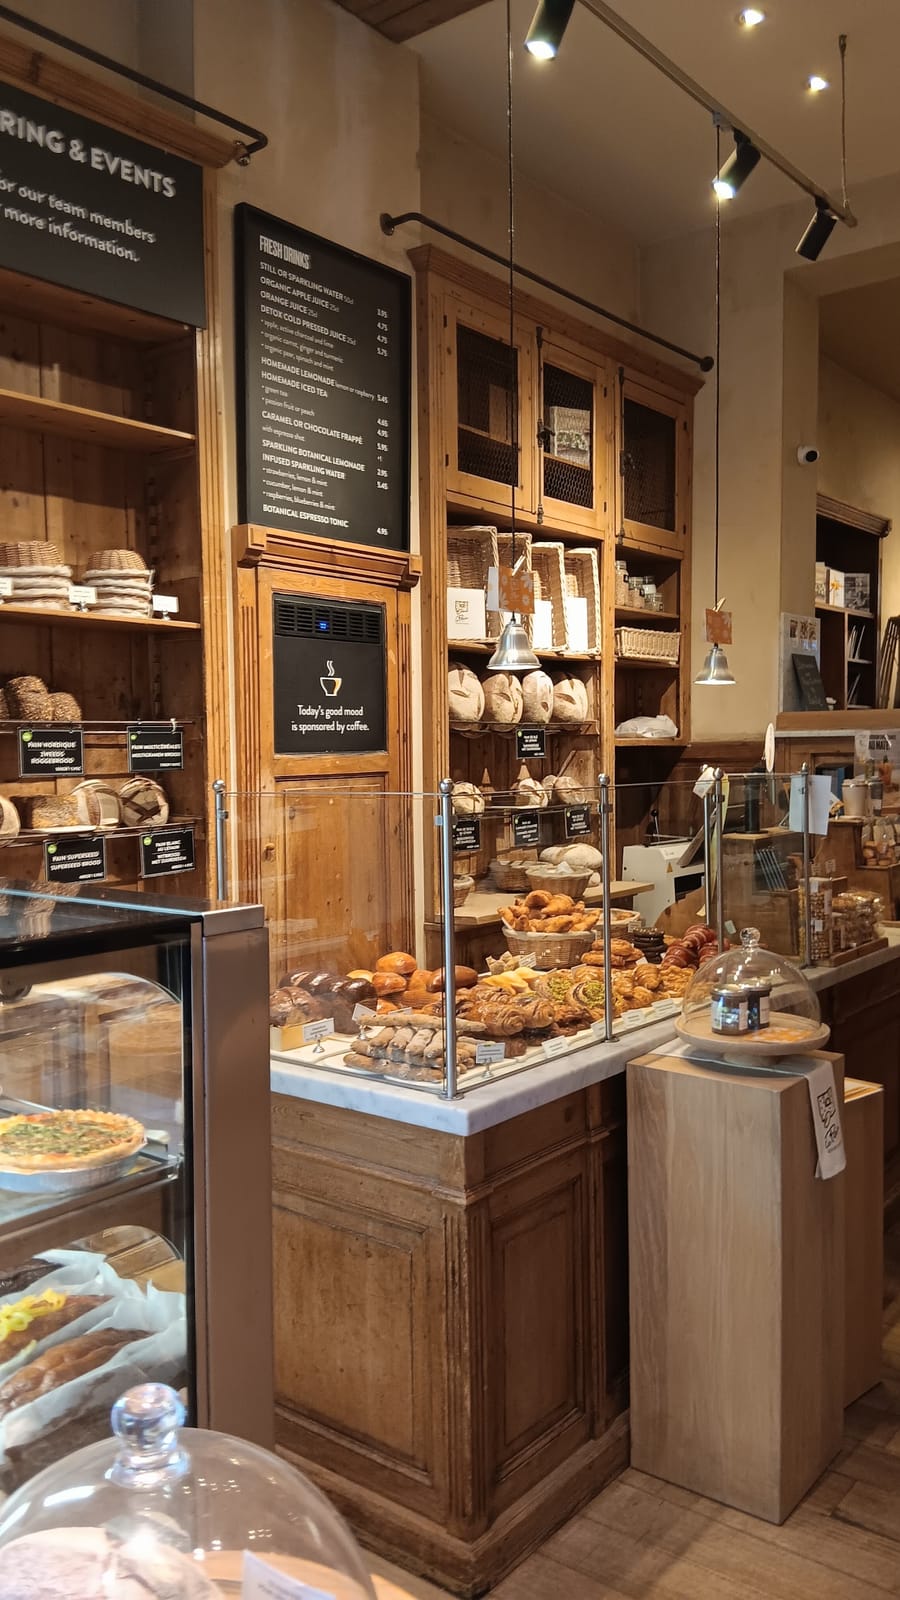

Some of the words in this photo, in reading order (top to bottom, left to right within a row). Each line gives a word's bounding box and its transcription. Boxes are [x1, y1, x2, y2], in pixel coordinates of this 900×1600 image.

[69, 138, 87, 163] &
[90, 147, 177, 198] EVENTS
[0, 169, 17, 193] or
[18, 186, 47, 204] our
[48, 194, 86, 219] team
[90, 210, 156, 243] members
[4, 206, 46, 230] more
[48, 215, 140, 262] information.
[260, 235, 283, 259] FRESH
[283, 245, 310, 270] DRINKS
[260, 261, 277, 275] STILL
[277, 269, 288, 279] OR
[288, 273, 323, 293] SPARKLING
[323, 286, 344, 301] WATER
[260, 276, 291, 294] ORGANIC
[291, 288, 311, 302] APPLE
[311, 295, 329, 309] JUICE
[260, 290, 289, 307] ORANGE
[289, 301, 308, 314] JUICE
[260, 304, 282, 319] DETOX
[283, 313, 302, 325] COLD
[302, 319, 329, 336] PRESSED
[329, 330, 347, 343] JUICE
[261, 356, 300, 376] HOMEMADE
[300, 368, 335, 387] LEMONADE
[261, 370, 300, 390] HOMEMADE
[300, 383, 317, 394] ICED
[316, 387, 328, 398] TEA
[261, 410, 293, 426] CARAMEL
[293, 419, 304, 429] OR
[303, 422, 341, 439] CHOCOLATE
[262, 439, 298, 455] SPARKLING
[298, 448, 332, 464] BOTANICAL
[332, 456, 366, 472] LEMONADE
[262, 453, 290, 467] INFUSED
[290, 460, 325, 475] SPARKLING
[325, 468, 346, 480] WATER
[262, 503, 300, 518] BOTANICAL
[299, 511, 330, 524] ESPRESSO
[329, 517, 350, 528] TONIC
[291, 720, 298, 731] is
[298, 720, 336, 734] sponsored
[336, 720, 346, 734] by
[346, 720, 370, 731] coffee.
[297, 704, 325, 719] Today's
[325, 705, 343, 720] good
[343, 706, 364, 716] mood
